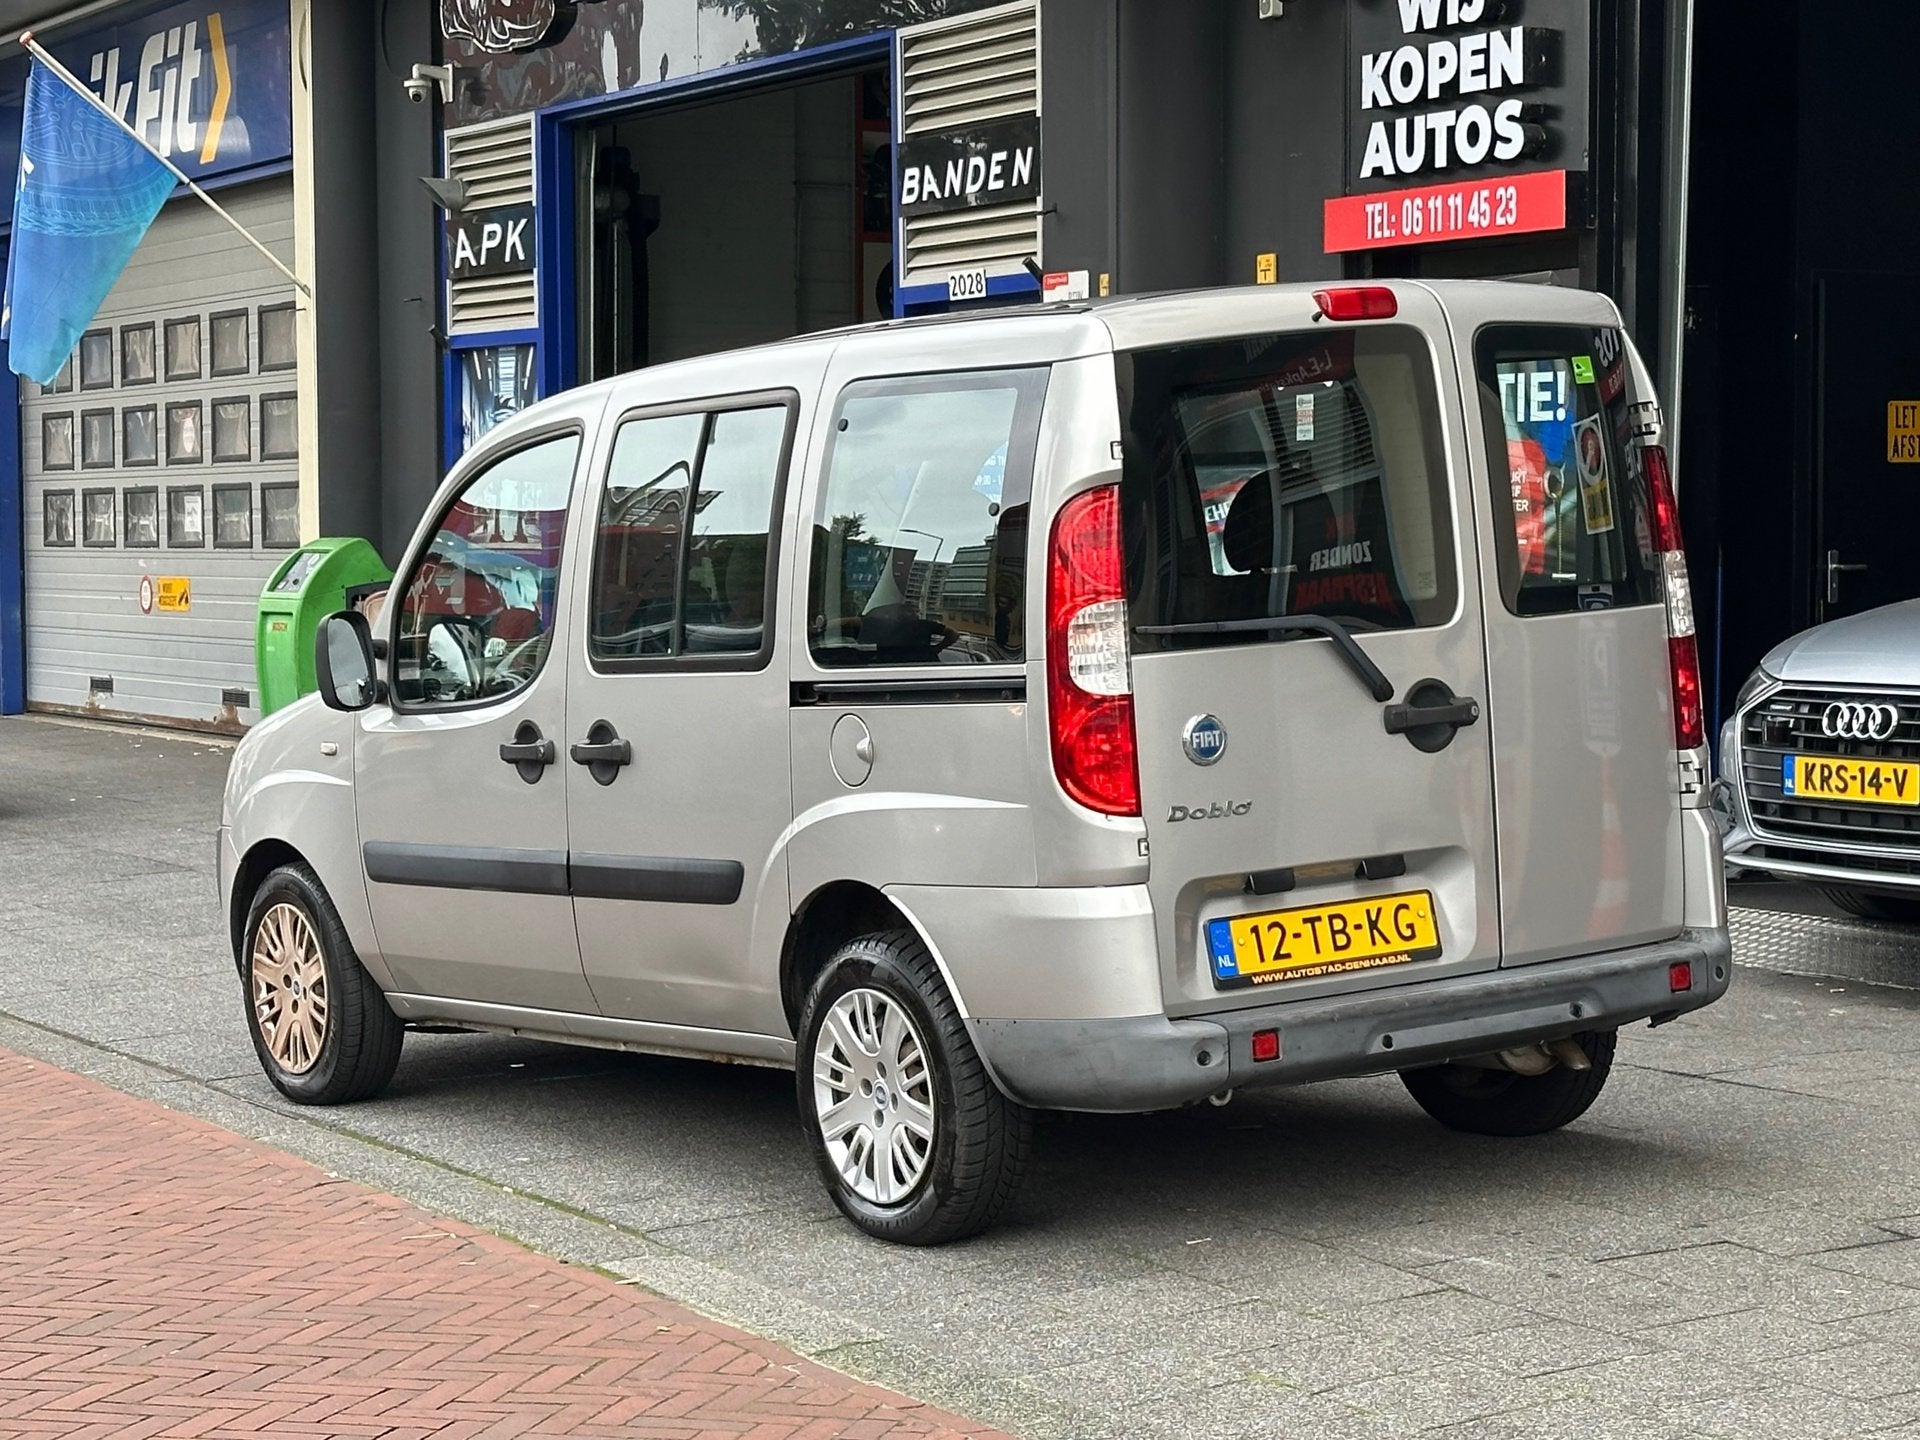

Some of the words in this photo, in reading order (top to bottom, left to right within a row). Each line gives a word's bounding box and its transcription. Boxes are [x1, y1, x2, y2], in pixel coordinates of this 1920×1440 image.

[1361, 25, 1524, 110] KOPEN
[1359, 99, 1525, 179] AUTOS
[901, 146, 1034, 205] BANDEN
[1365, 201, 1397, 240] TEL:
[1402, 197, 1423, 237] 06
[1427, 195, 1443, 234] 11
[1447, 192, 1463, 232] 11
[1467, 189, 1491, 229] 45
[1495, 185, 1517, 226] 23
[454, 218, 528, 269] APK
[949, 272, 984, 297] 2028
[1895, 405, 1917, 429] LET
[1191, 729, 1221, 749] FIAT
[1784, 778, 1795, 789] NL
[1804, 762, 1909, 798] KRS-14-V
[1249, 902, 1417, 964] 12-TB-KG
[1217, 954, 1235, 968] NL
